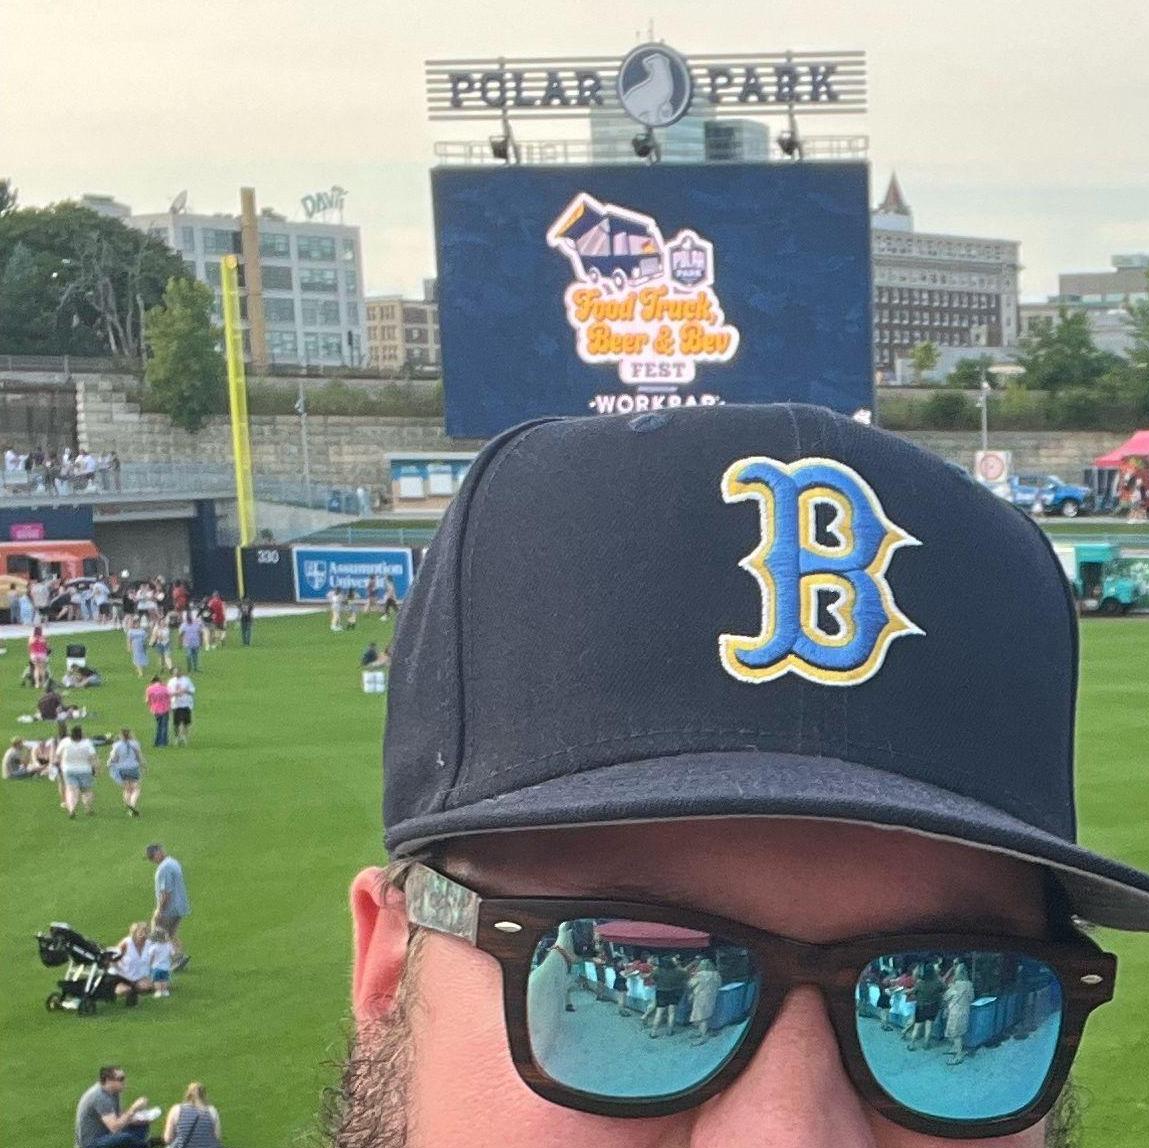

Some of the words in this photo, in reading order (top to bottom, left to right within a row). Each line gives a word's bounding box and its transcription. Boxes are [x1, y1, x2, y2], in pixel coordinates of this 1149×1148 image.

[448, 70, 605, 108] POLAR
[709, 64, 841, 102] PARK
[573, 288, 638, 322] Food
[587, 322, 649, 355] Beer
[653, 325, 675, 355] &
[680, 322, 731, 355] Bev
[631, 362, 687, 378] FEST
[718, 456, 926, 686] B
